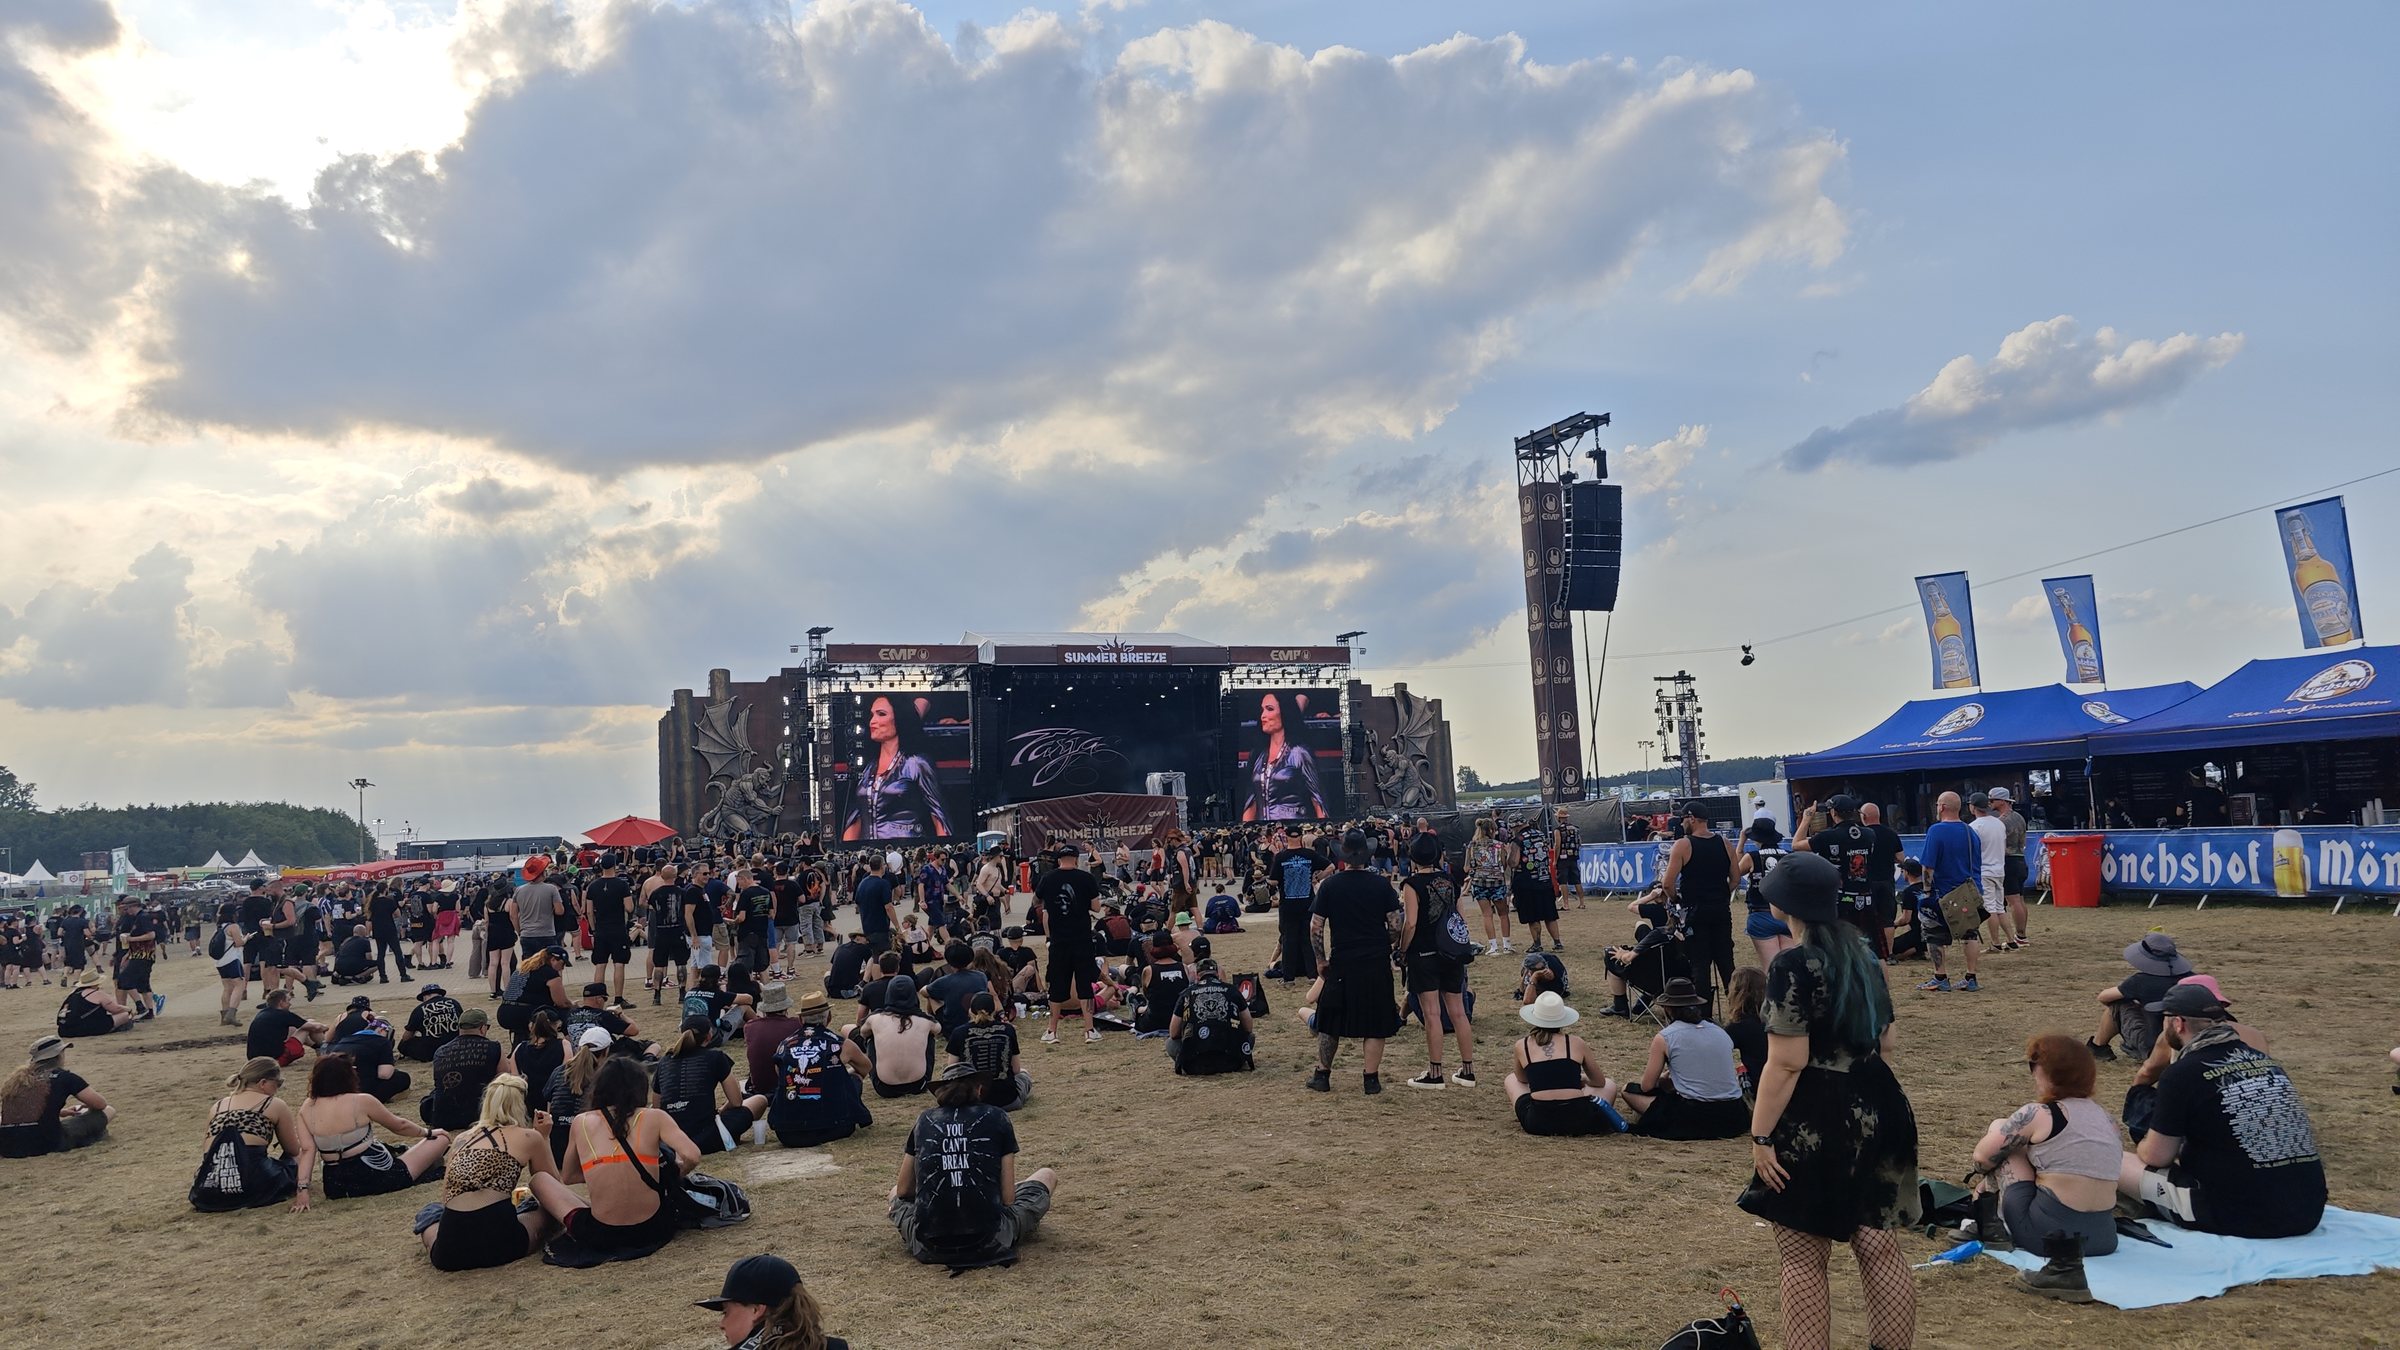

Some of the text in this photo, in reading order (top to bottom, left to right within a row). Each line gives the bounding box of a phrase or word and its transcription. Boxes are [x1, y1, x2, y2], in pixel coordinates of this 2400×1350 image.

[1522, 514, 1535, 524] EMP
[1542, 513, 1560, 521] EMP
[879, 648, 917, 661] EMP
[1064, 652, 1167, 663] SUMMER BREEZE
[1270, 650, 1301, 661] EMP
[1558, 731, 1576, 740] EMP
[1046, 824, 1153, 840] SUMMER BREEZE
[1579, 852, 1644, 885] nchshof
[2101, 840, 2260, 887] önchshof
[421, 999, 455, 1016] KISS
[422, 1012, 459, 1027] COBRA
[425, 1020, 459, 1038] KING
[2202, 1062, 2252, 1080] SUMMER
[946, 1123, 964, 1137] YOU
[942, 1138, 968, 1153] CAN'T
[942, 1153, 970, 1171] BREAK
[950, 1170, 963, 1188] ME
